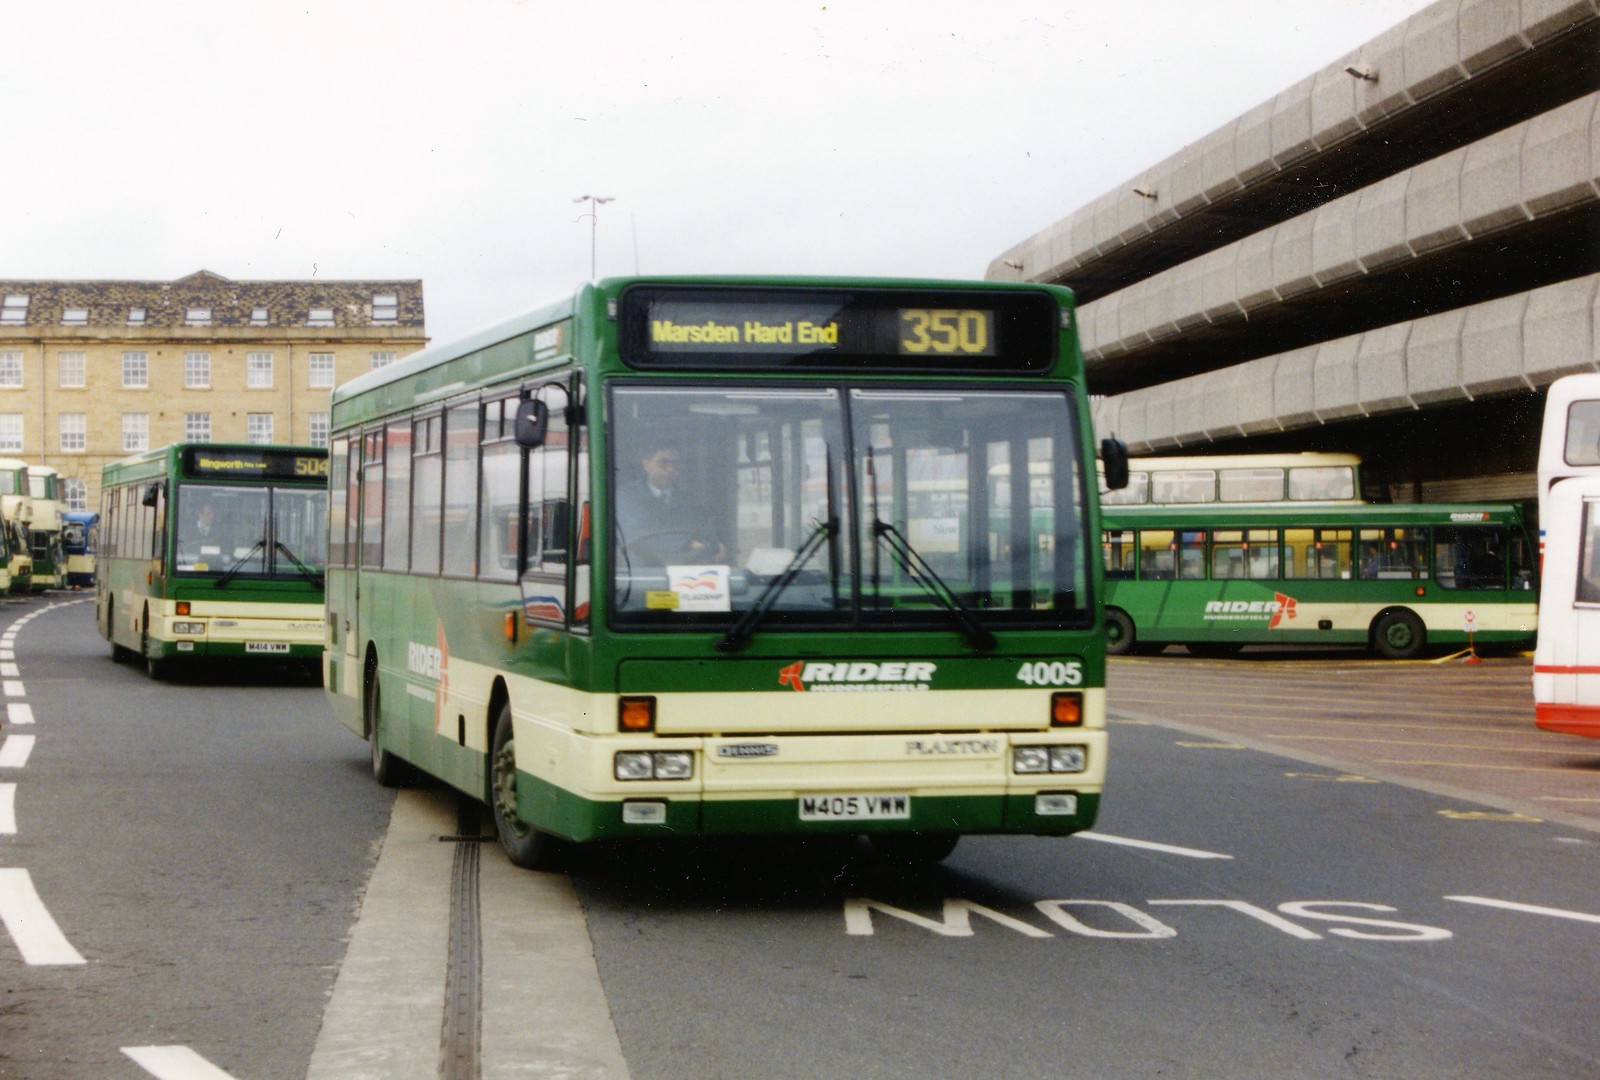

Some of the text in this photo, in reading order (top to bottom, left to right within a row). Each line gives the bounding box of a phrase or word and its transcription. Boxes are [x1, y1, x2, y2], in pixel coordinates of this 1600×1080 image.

[653, 320, 838, 343] Marsden Hard End
[902, 309, 987, 352] 350
[296, 457, 328, 475] 504
[1205, 601, 1282, 613] RIDER
[248, 643, 268, 651] M414
[408, 641, 442, 680] RIDER
[801, 662, 937, 682] RIDER
[1016, 661, 1082, 686] 4005
[718, 743, 778, 758] DENNIS
[906, 741, 998, 755] PLAXTON
[803, 797, 906, 816] M405 VWW
[844, 899, 1453, 941] SLOW
